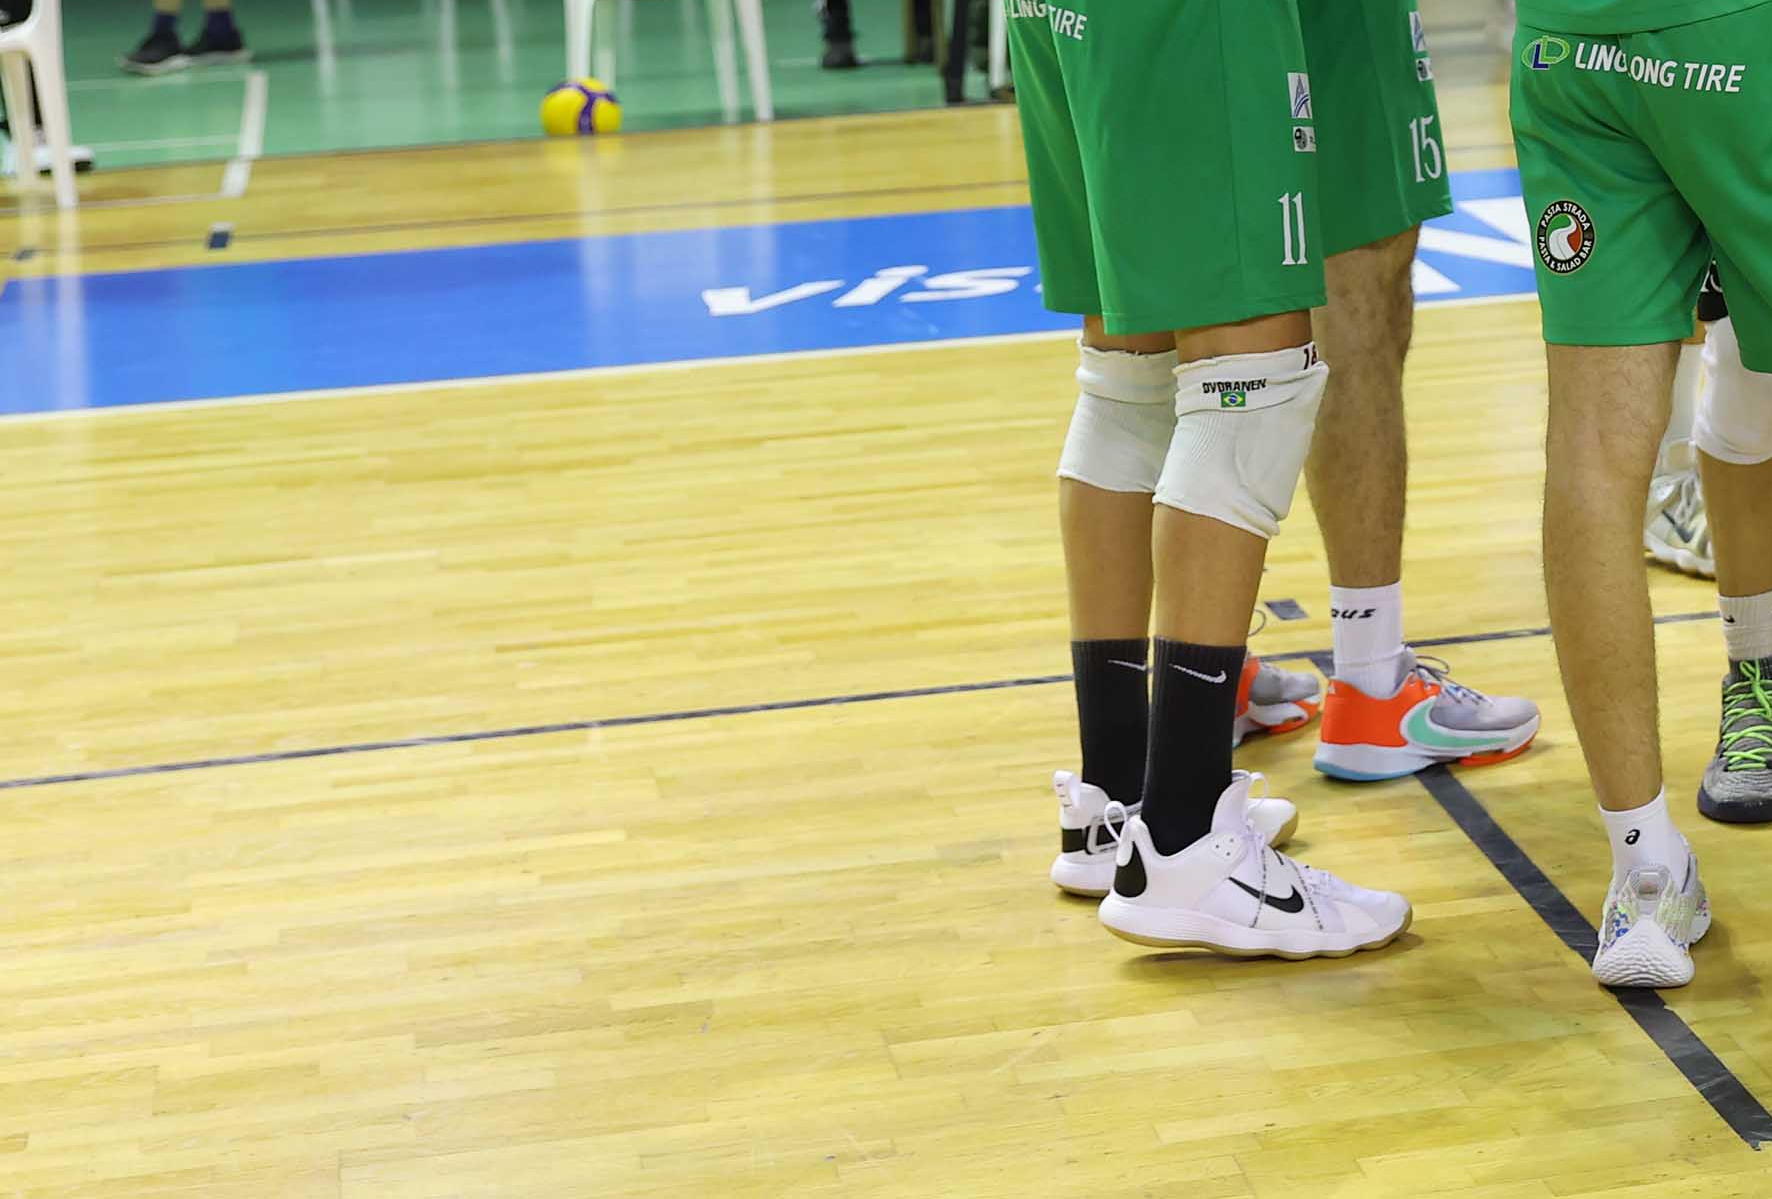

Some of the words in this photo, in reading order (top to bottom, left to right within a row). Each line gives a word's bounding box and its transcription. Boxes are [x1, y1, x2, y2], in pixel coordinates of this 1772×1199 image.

[1574, 42, 1678, 88] LINGONG
[1683, 62, 1746, 93] TIRE
[1409, 115, 1442, 183] 15
[1277, 192, 1308, 265] 11
[1541, 203, 1562, 228] PASTA
[1562, 202, 1591, 231] STRADA
[1539, 236, 1551, 264] PASTA
[1550, 261, 1556, 269] &
[1556, 257, 1582, 272] SALAD
[1579, 240, 1592, 259] BAR
[701, 265, 1042, 317] vis
